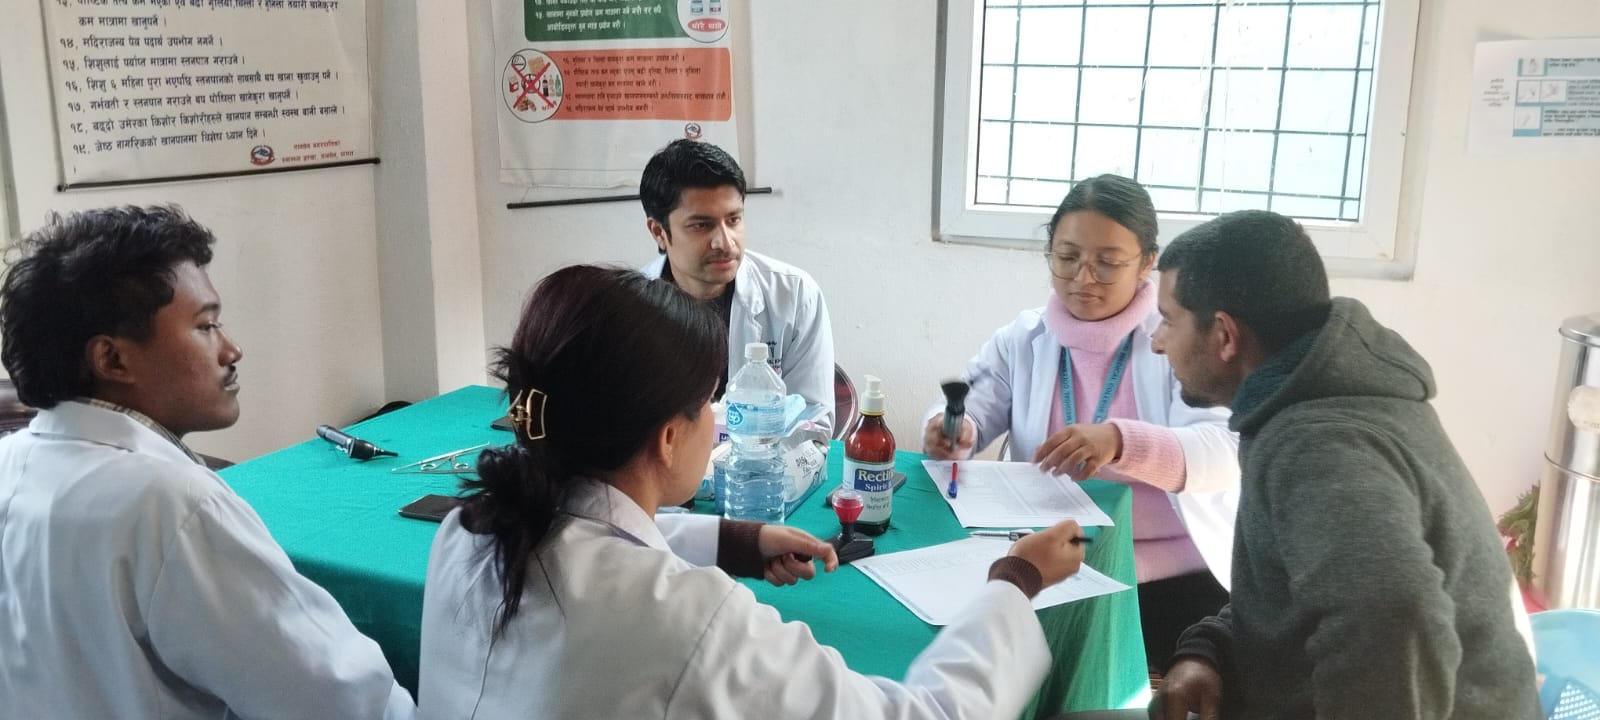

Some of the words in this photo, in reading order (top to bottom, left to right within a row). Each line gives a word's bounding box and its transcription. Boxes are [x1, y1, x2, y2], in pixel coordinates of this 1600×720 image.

[78, 16, 94, 26] कम
[98, 16, 127, 26] मात्रामा
[150, 57, 177, 67] मात्रामा
